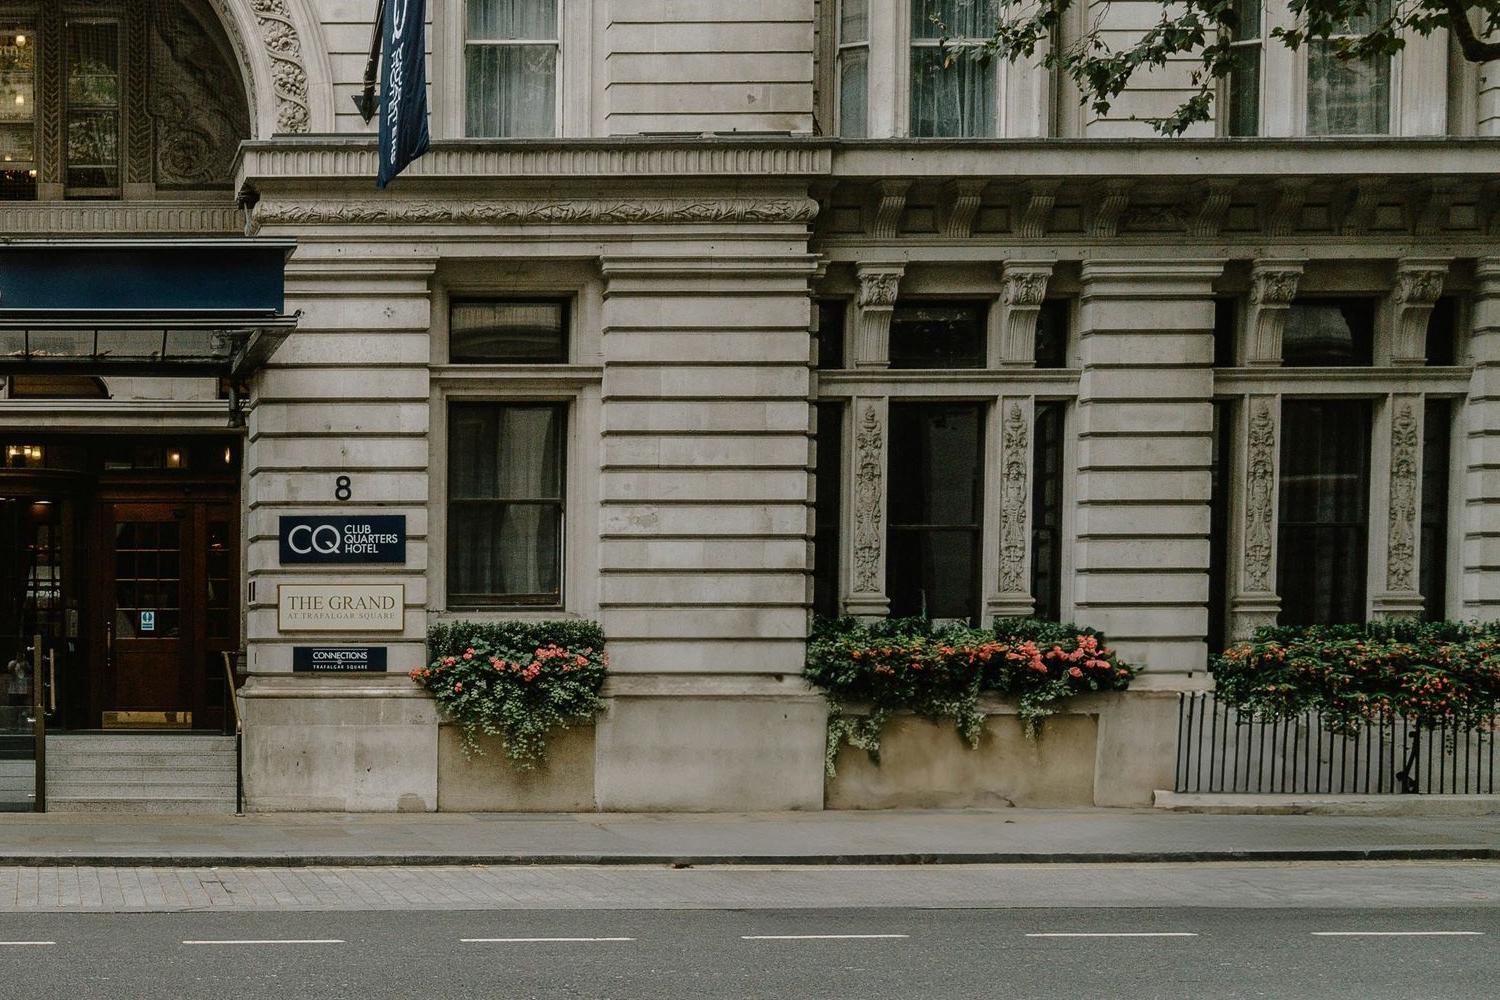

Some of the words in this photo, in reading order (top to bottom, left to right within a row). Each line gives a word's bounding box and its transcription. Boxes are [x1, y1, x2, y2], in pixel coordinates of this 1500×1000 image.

[335, 475, 351, 500] 8
[344, 524, 371, 534] CLUB
[288, 524, 341, 554] CQ
[344, 534, 398, 544] QUARTERS
[345, 544, 379, 553] HOTEL
[287, 595, 324, 610] THE
[328, 595, 395, 610] GRAND
[359, 612, 395, 620] SQUARE
[312, 651, 368, 659] CONNECTIONS
